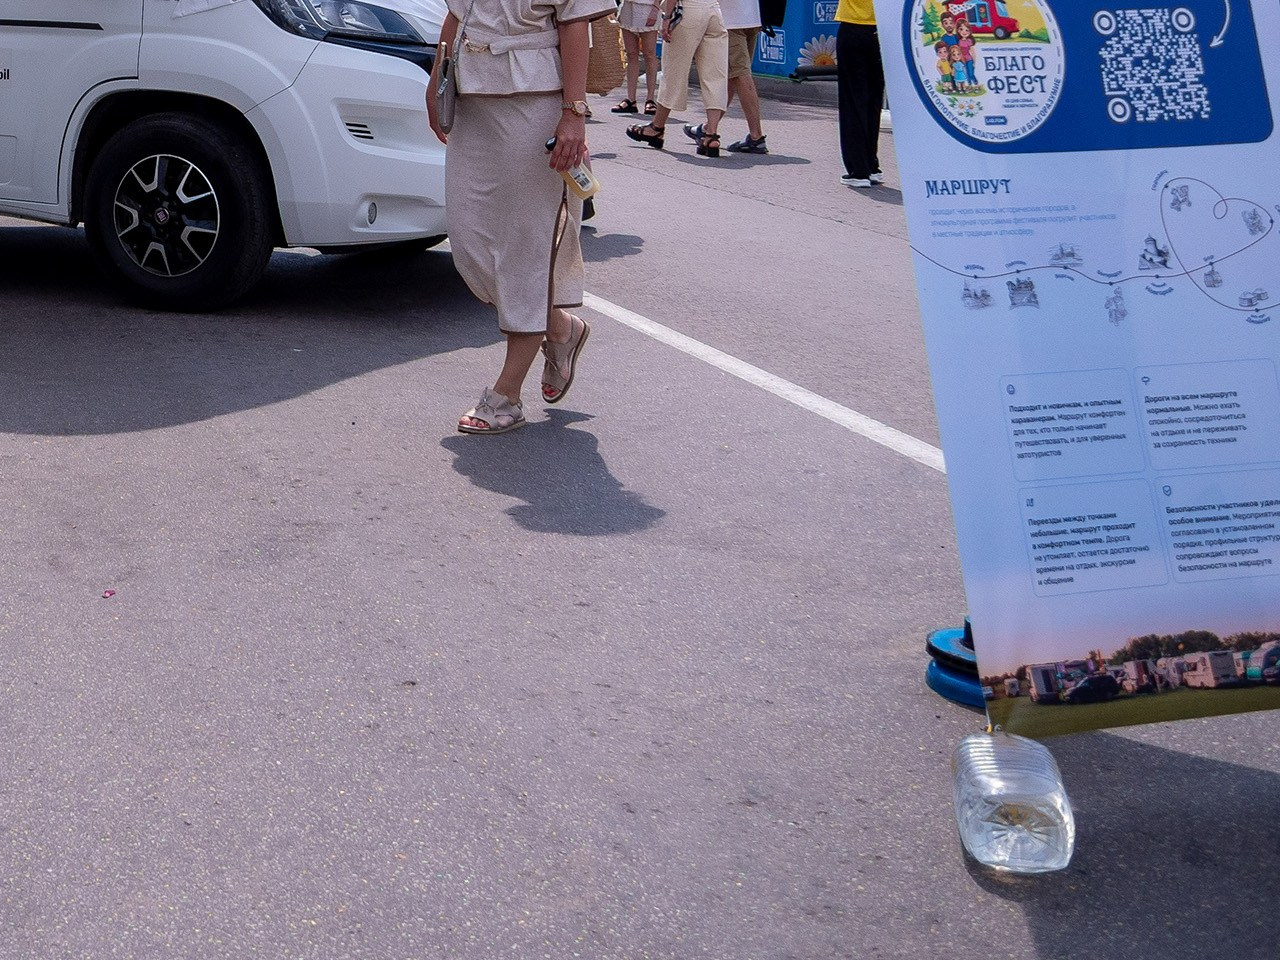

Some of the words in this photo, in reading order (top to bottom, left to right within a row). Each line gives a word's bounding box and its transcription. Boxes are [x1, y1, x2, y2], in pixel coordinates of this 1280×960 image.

[984, 55, 1045, 72] БЛАГО
[987, 76, 1047, 94] ФЕСТ
[923, 80, 970, 134] БЛАГОПОЛУЧИЕ,
[972, 128, 1020, 140] БЛАГОЧЕСТИЕ
[1026, 78, 1061, 130] БЛАГОРАЗУМИЕ
[924, 179, 1011, 198] МАРШРУТ
[1199, 391, 1237, 399] маршруте
[1056, 412, 1087, 420] Маршрут
[1183, 413, 1246, 423] сосредоточиться
[1074, 422, 1107, 430] начинает
[1202, 424, 1247, 433] переживать
[1088, 433, 1127, 442] уверенных
[1161, 439, 1206, 447] сохранность
[1016, 450, 1062, 458] автотуристов
[1165, 504, 1216, 513] Безопасности
[1216, 501, 1259, 510] участников
[1027, 518, 1062, 526] Переезды
[1168, 516, 1194, 525] особое
[1069, 525, 1101, 534] маршрут
[1101, 522, 1135, 532] проходит
[1170, 528, 1214, 536] согласовано
[1220, 523, 1274, 534] установленном
[1036, 540, 1081, 549] комфортном
[1105, 535, 1130, 543] Дорога
[1204, 537, 1247, 546] профильные
[1109, 545, 1150, 555] достаточно
[1175, 550, 1228, 560] сопровождают
[1035, 565, 1065, 574] времени
[1099, 558, 1136, 567] экскурсии
[1177, 562, 1227, 572] безопасности
[1237, 558, 1272, 567] маршруте
[1042, 576, 1074, 585] общение
